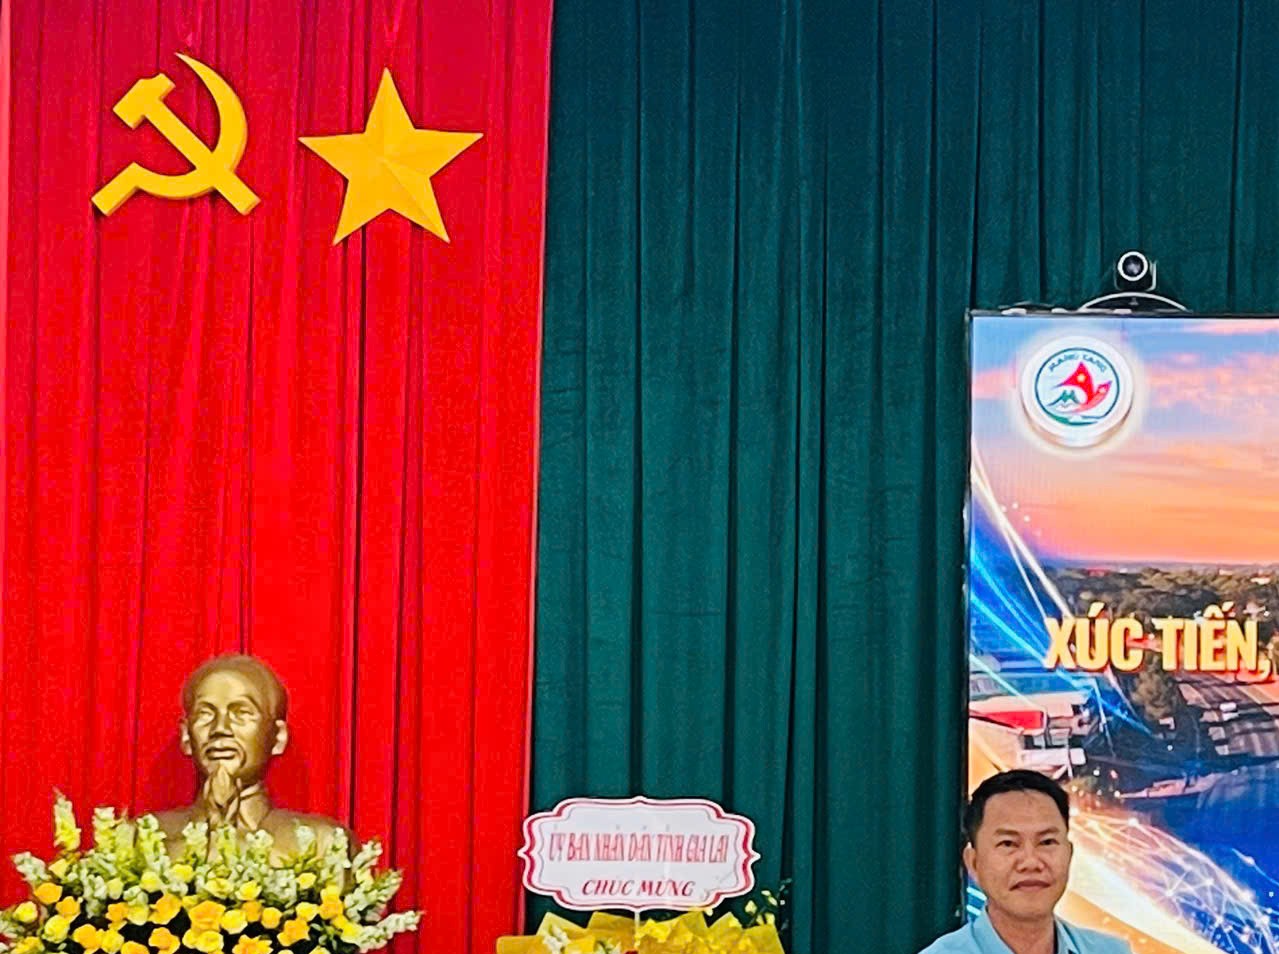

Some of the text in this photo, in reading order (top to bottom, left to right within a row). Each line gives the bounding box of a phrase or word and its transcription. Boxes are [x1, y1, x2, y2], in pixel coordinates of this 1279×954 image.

[1043, 605, 1144, 672] XÚC
[1158, 603, 1273, 681] TIẾN,
[567, 832, 590, 861] BAN
[709, 833, 729, 862] LAI
